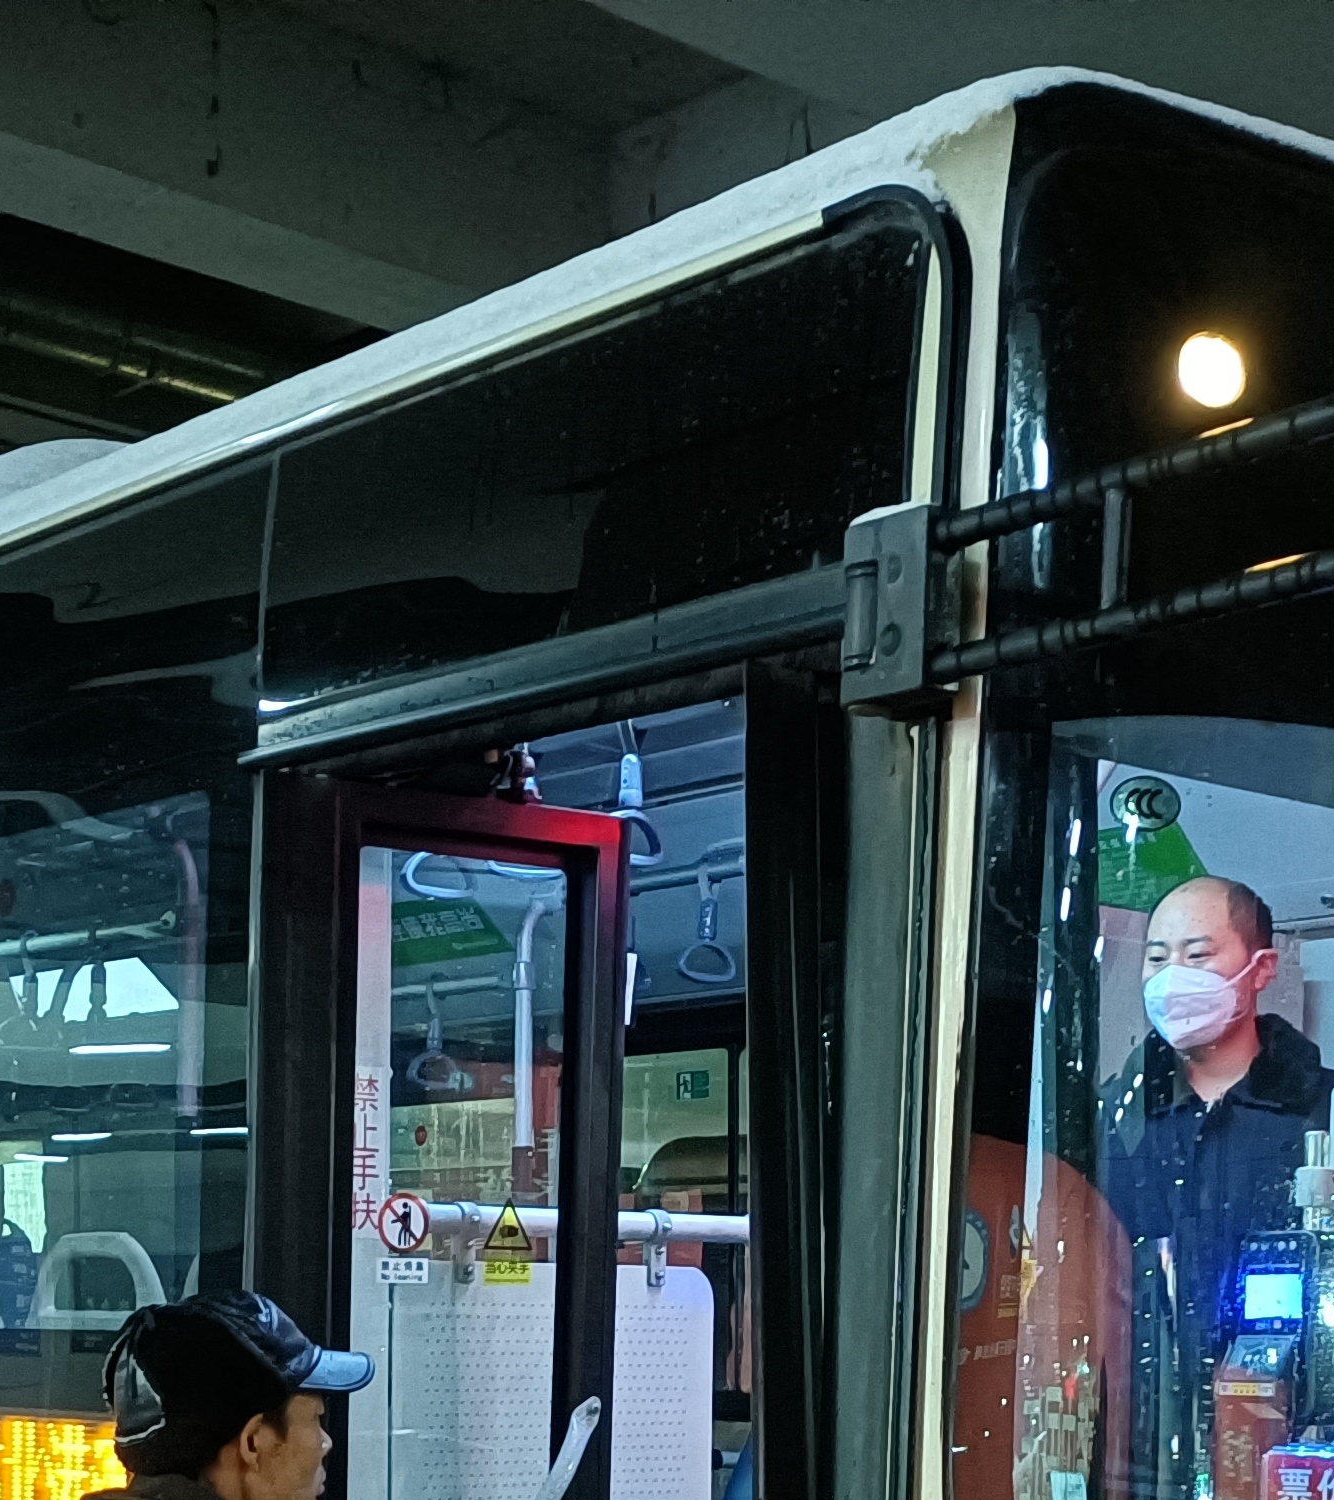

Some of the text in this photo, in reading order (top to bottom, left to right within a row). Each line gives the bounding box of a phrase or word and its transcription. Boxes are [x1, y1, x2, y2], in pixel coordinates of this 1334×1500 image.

[1125, 788, 1163, 819] CCC
[352, 1072, 380, 1231] 禁止手扶
[381, 1273, 391, 1281] No
[484, 1263, 530, 1275] 当心夹手
